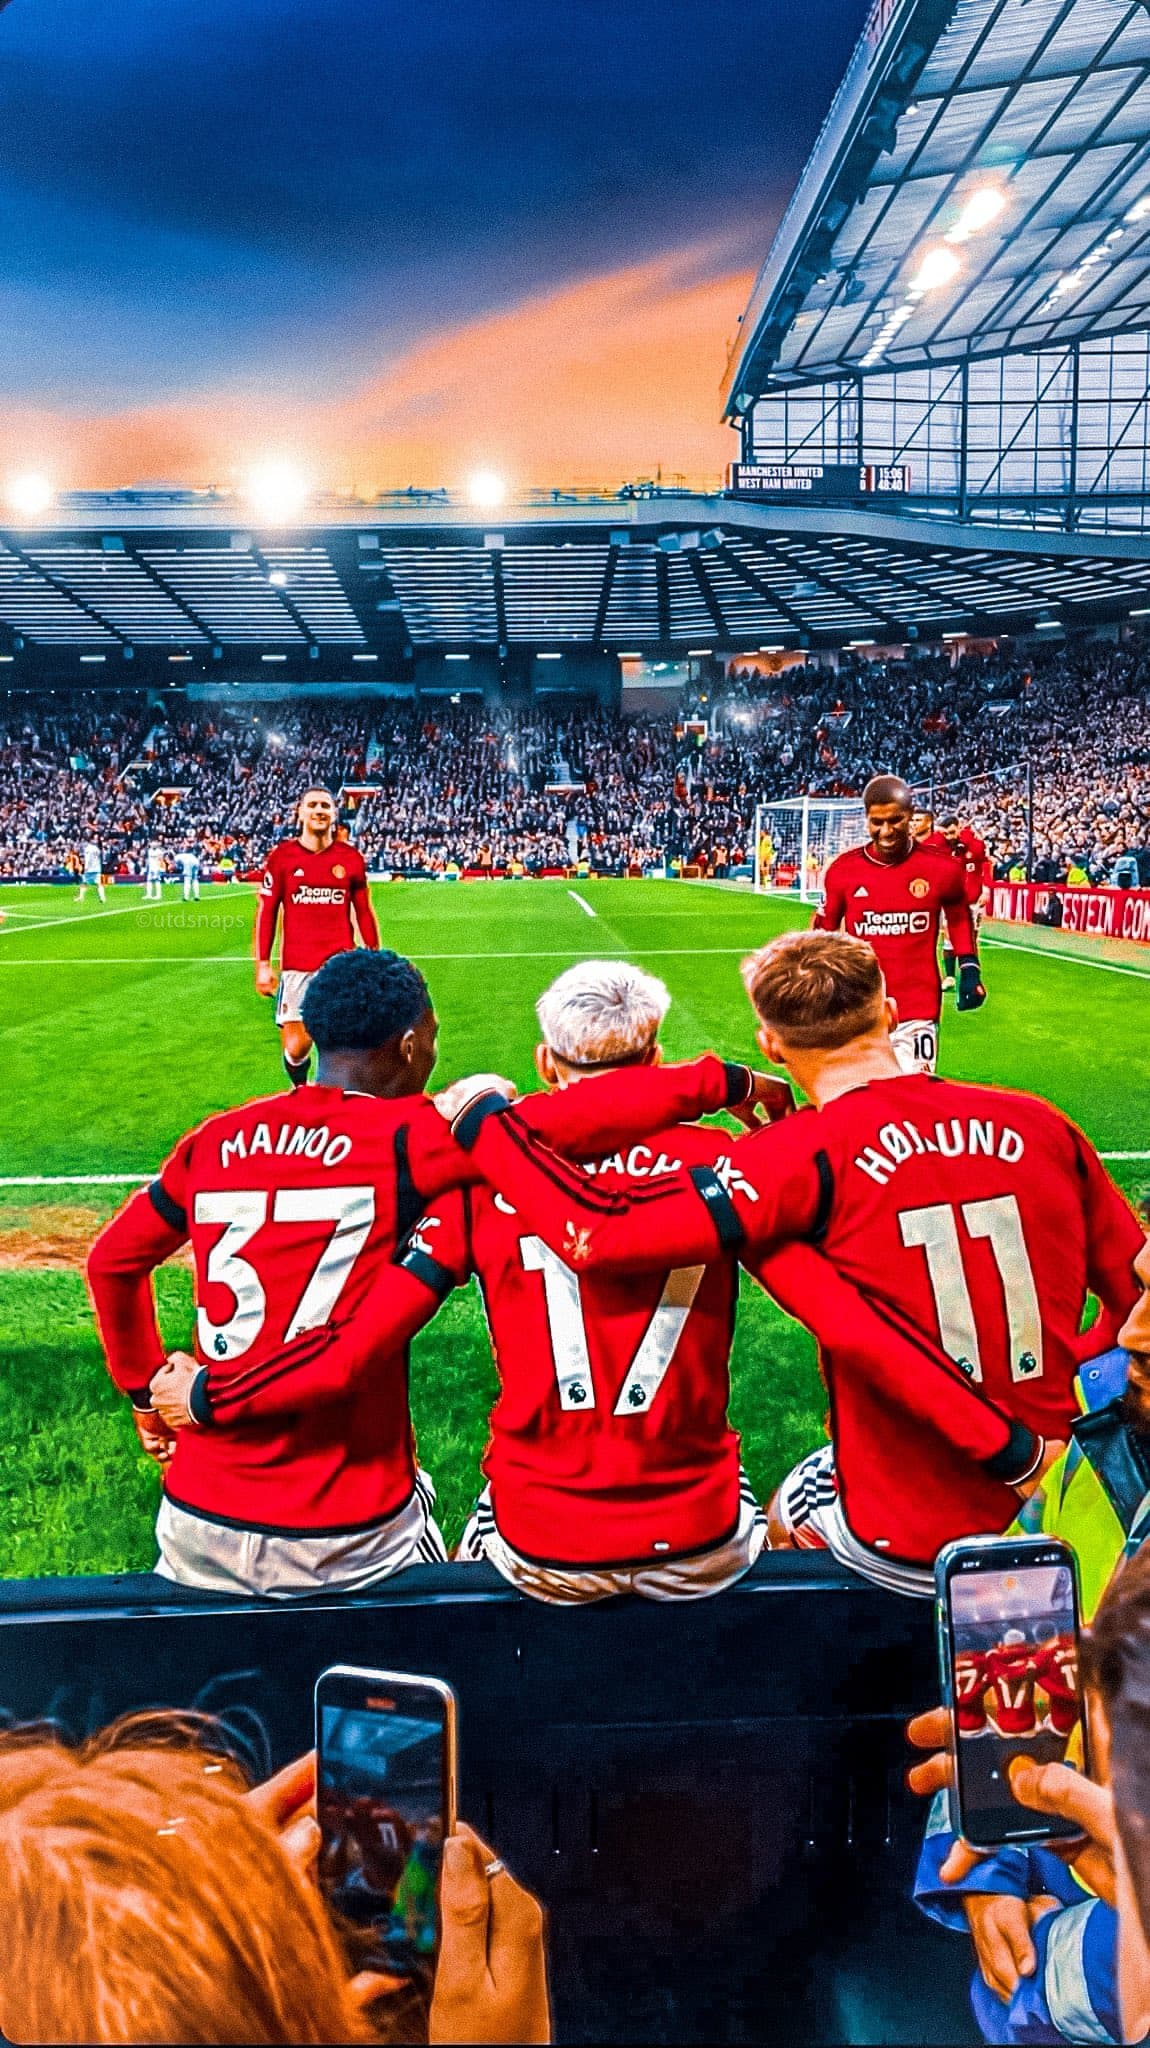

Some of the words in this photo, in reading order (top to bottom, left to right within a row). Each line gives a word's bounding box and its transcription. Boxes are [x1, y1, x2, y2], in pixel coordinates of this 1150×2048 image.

[738, 465, 793, 477] MANCHESTER
[794, 466, 823, 478] UNITED
[860, 467, 866, 478] 2
[738, 478, 760, 489] WEST
[762, 479, 781, 489] HAM
[782, 479, 812, 490] UNITED
[291, 893, 331, 904] Viewer
[299, 885, 331, 896] Team
[1016, 889, 1029, 923] AT
[863, 911, 908, 924] Team
[854, 922, 908, 936] Viewer
[914, 1033, 935, 1061] 10
[221, 1123, 352, 1168] MAINOO
[194, 1186, 376, 1361] 37
[898, 1194, 1044, 1383] 11
[519, 1235, 706, 1416] 17
